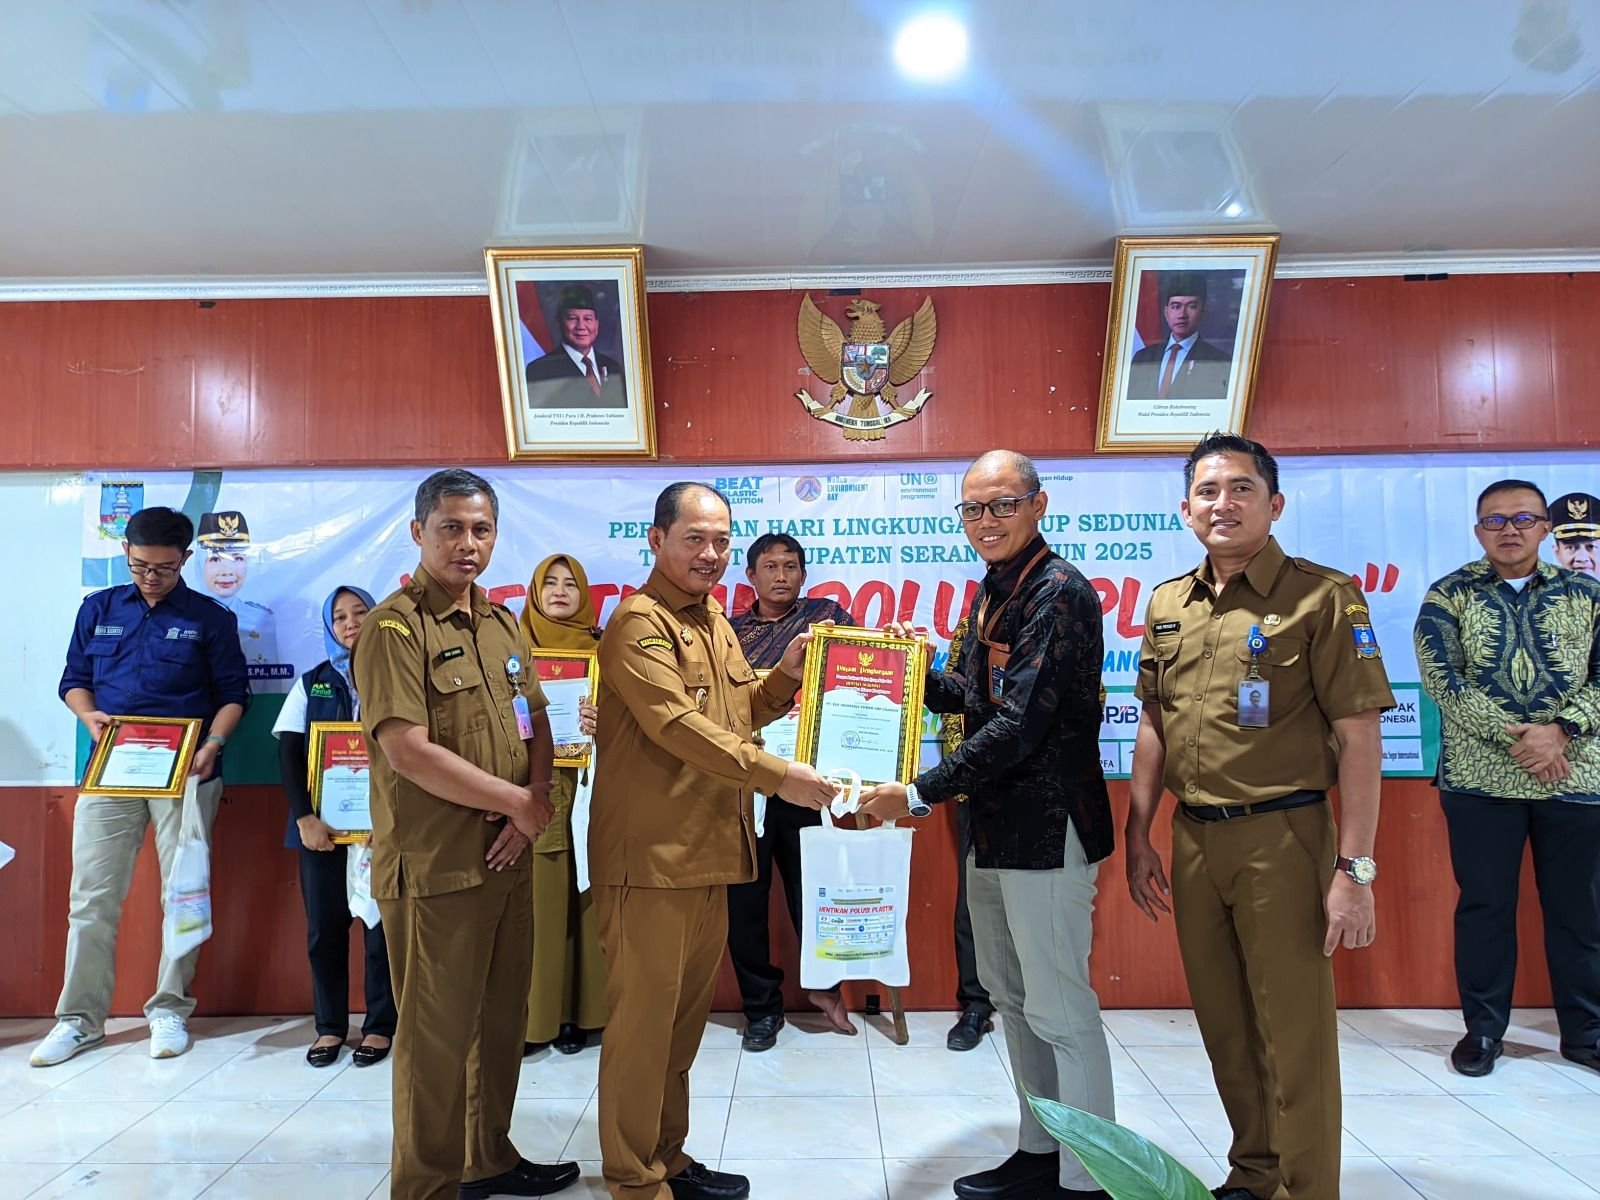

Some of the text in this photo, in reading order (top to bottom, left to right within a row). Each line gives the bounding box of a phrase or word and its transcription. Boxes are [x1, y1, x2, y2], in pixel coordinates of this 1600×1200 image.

[715, 477, 763, 490] BEAT
[900, 473, 921, 485] UN
[827, 484, 869, 492] ENVIRONMENT
[767, 518, 825, 537] HARI
[1078, 513, 1184, 532] SEDUNIA
[900, 545, 978, 563] SERAN
[1095, 542, 1153, 561] 2025
[270, 667, 290, 676] M.M.
[818, 906, 848, 914] HENTIKAN
[850, 906, 870, 914] POLUSI
